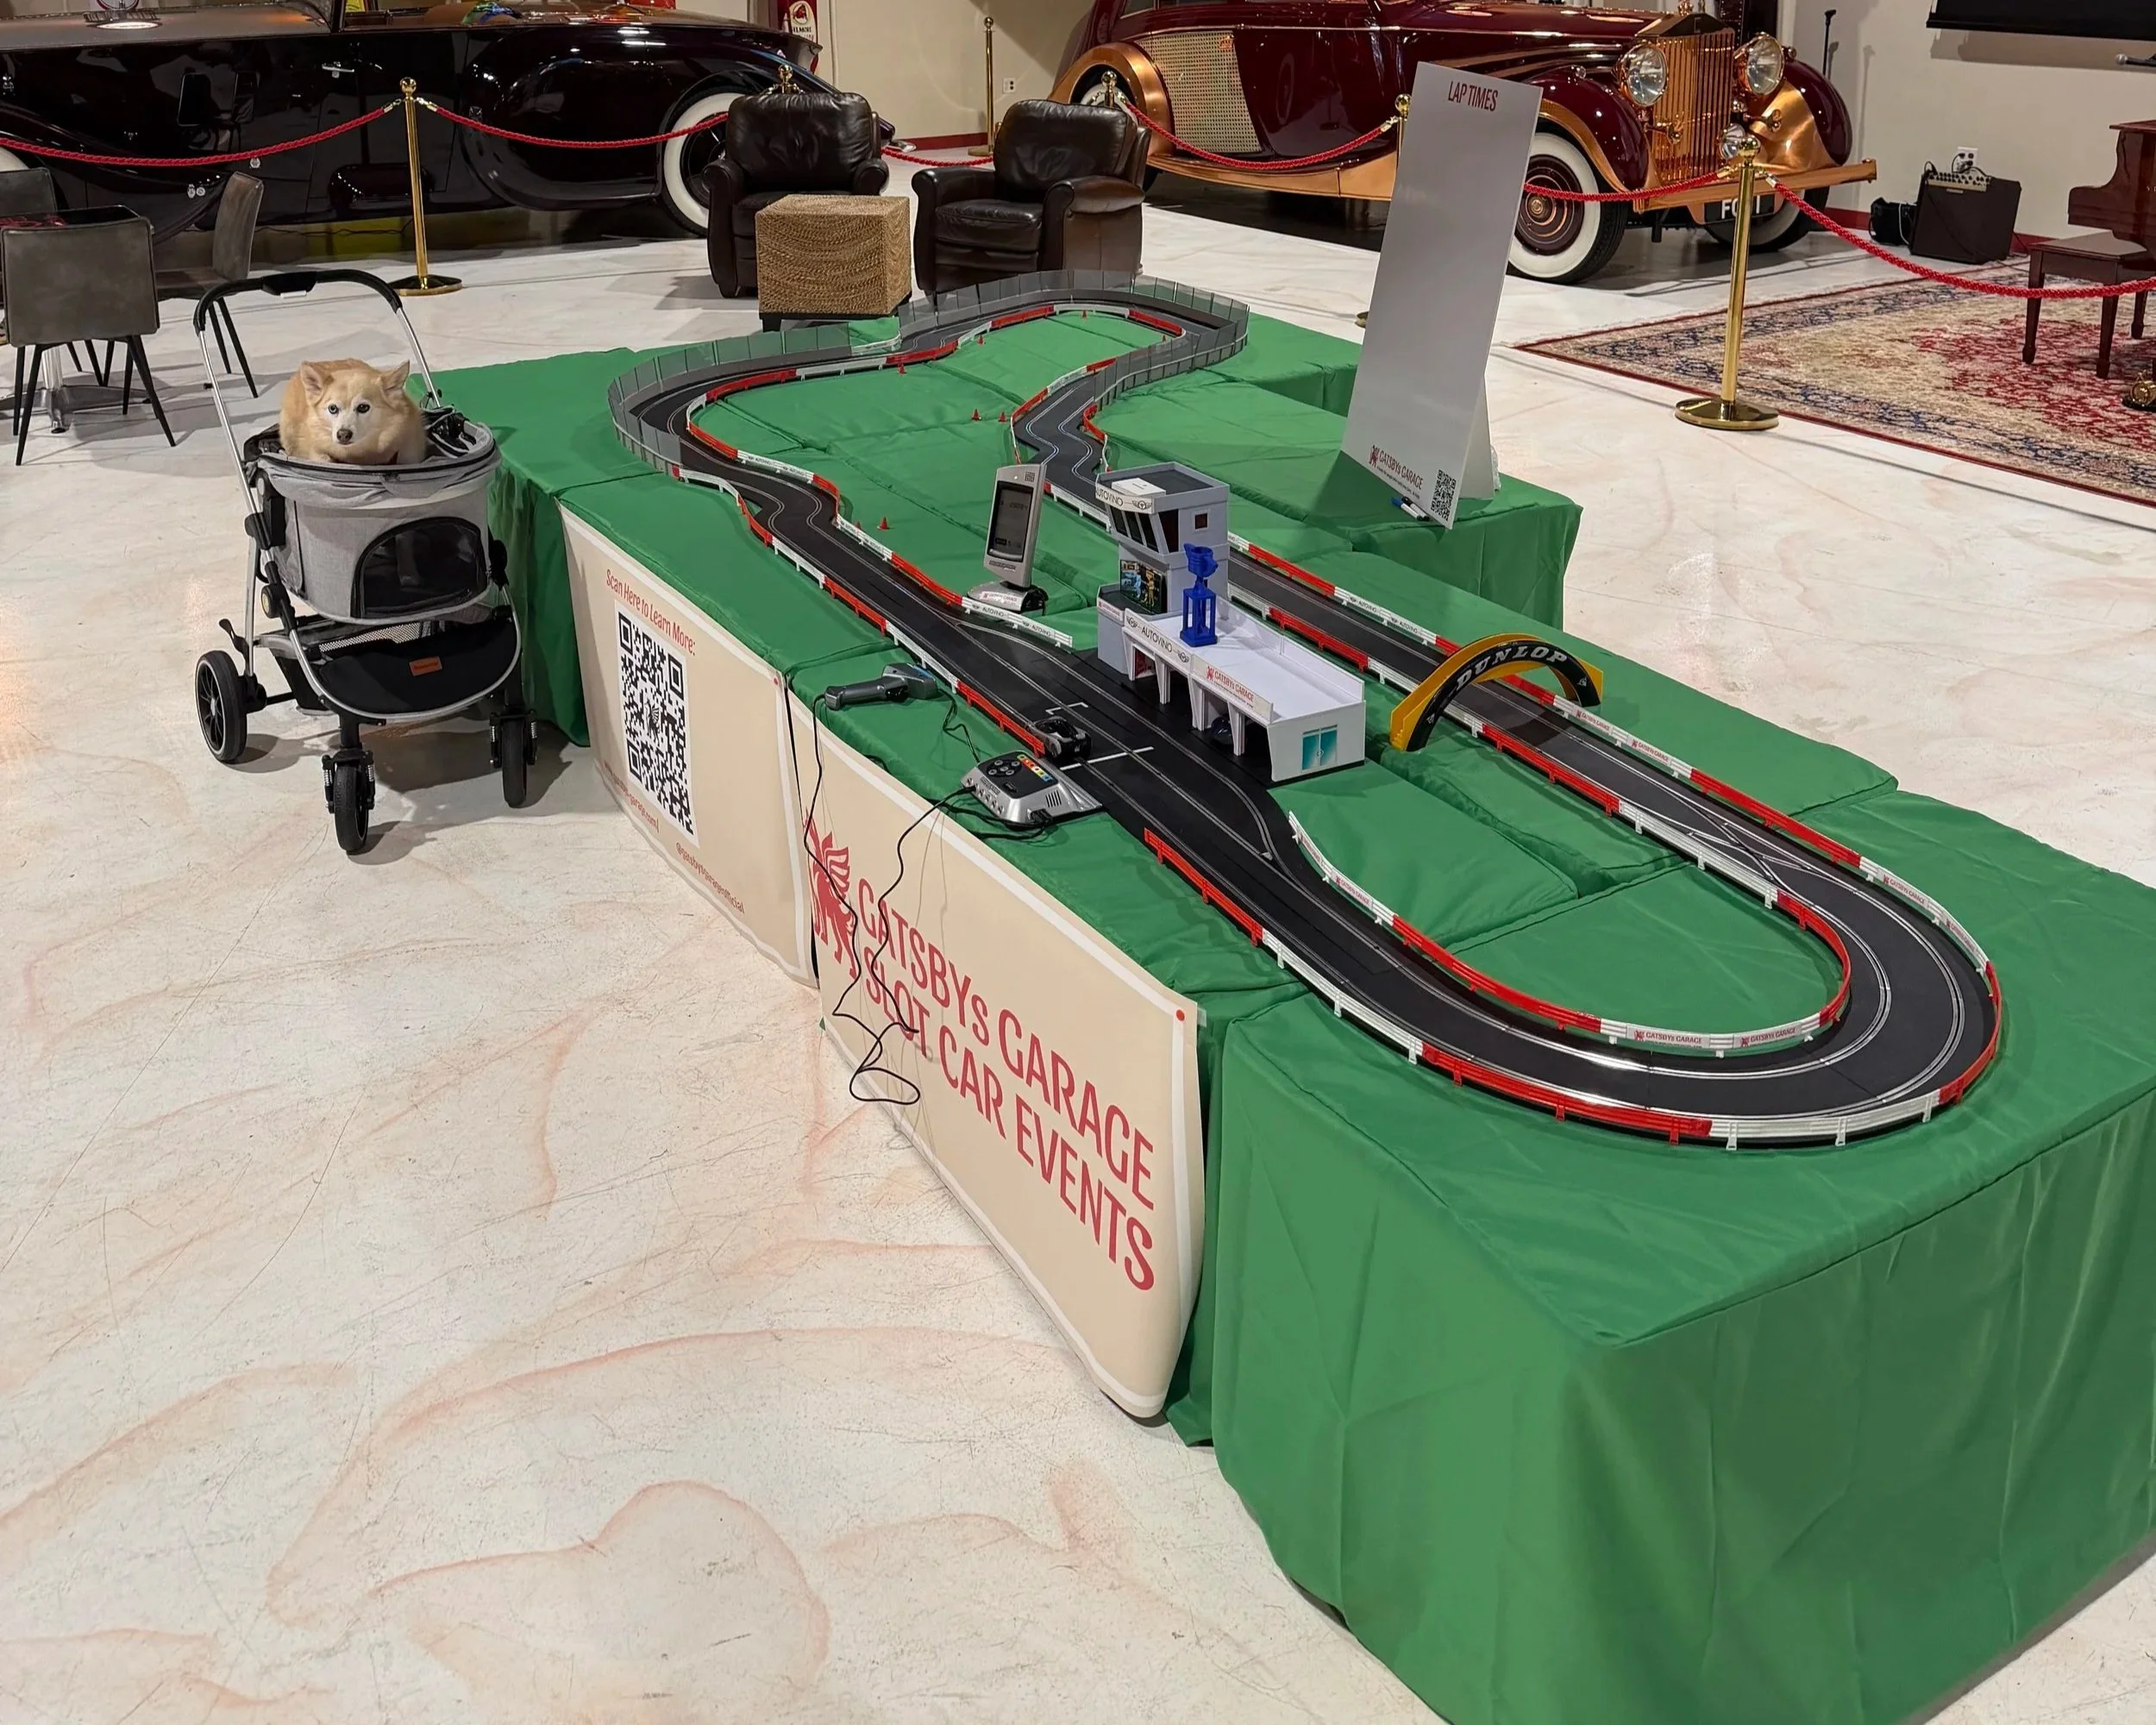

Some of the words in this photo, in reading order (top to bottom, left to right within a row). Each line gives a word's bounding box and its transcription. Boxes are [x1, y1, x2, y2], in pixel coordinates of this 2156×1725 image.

[1448, 80, 1467, 104] LAP
[1468, 85, 1499, 112] TIMES
[1401, 466, 1423, 490] GARAGE
[1096, 486, 1124, 507] UTOVINO
[606, 568, 623, 597] Scan
[624, 582, 641, 611] Here
[641, 599, 649, 618] to
[649, 604, 671, 637] Learn
[672, 622, 696, 656] More:
[1141, 626, 1173, 653] AUTOVINO
[1456, 645, 1568, 691] DUNLOP
[1235, 680, 1255, 703] GARAGE
[1676, 1034, 1702, 1044] GARAGE
[1775, 1026, 1796, 1038] GARAGE
[863, 945, 931, 1059] SLOT
[939, 1025, 1006, 1140] CAR
[1015, 1093, 1155, 1291] EVENTS
[998, 1008, 1155, 1211] GARAGE
